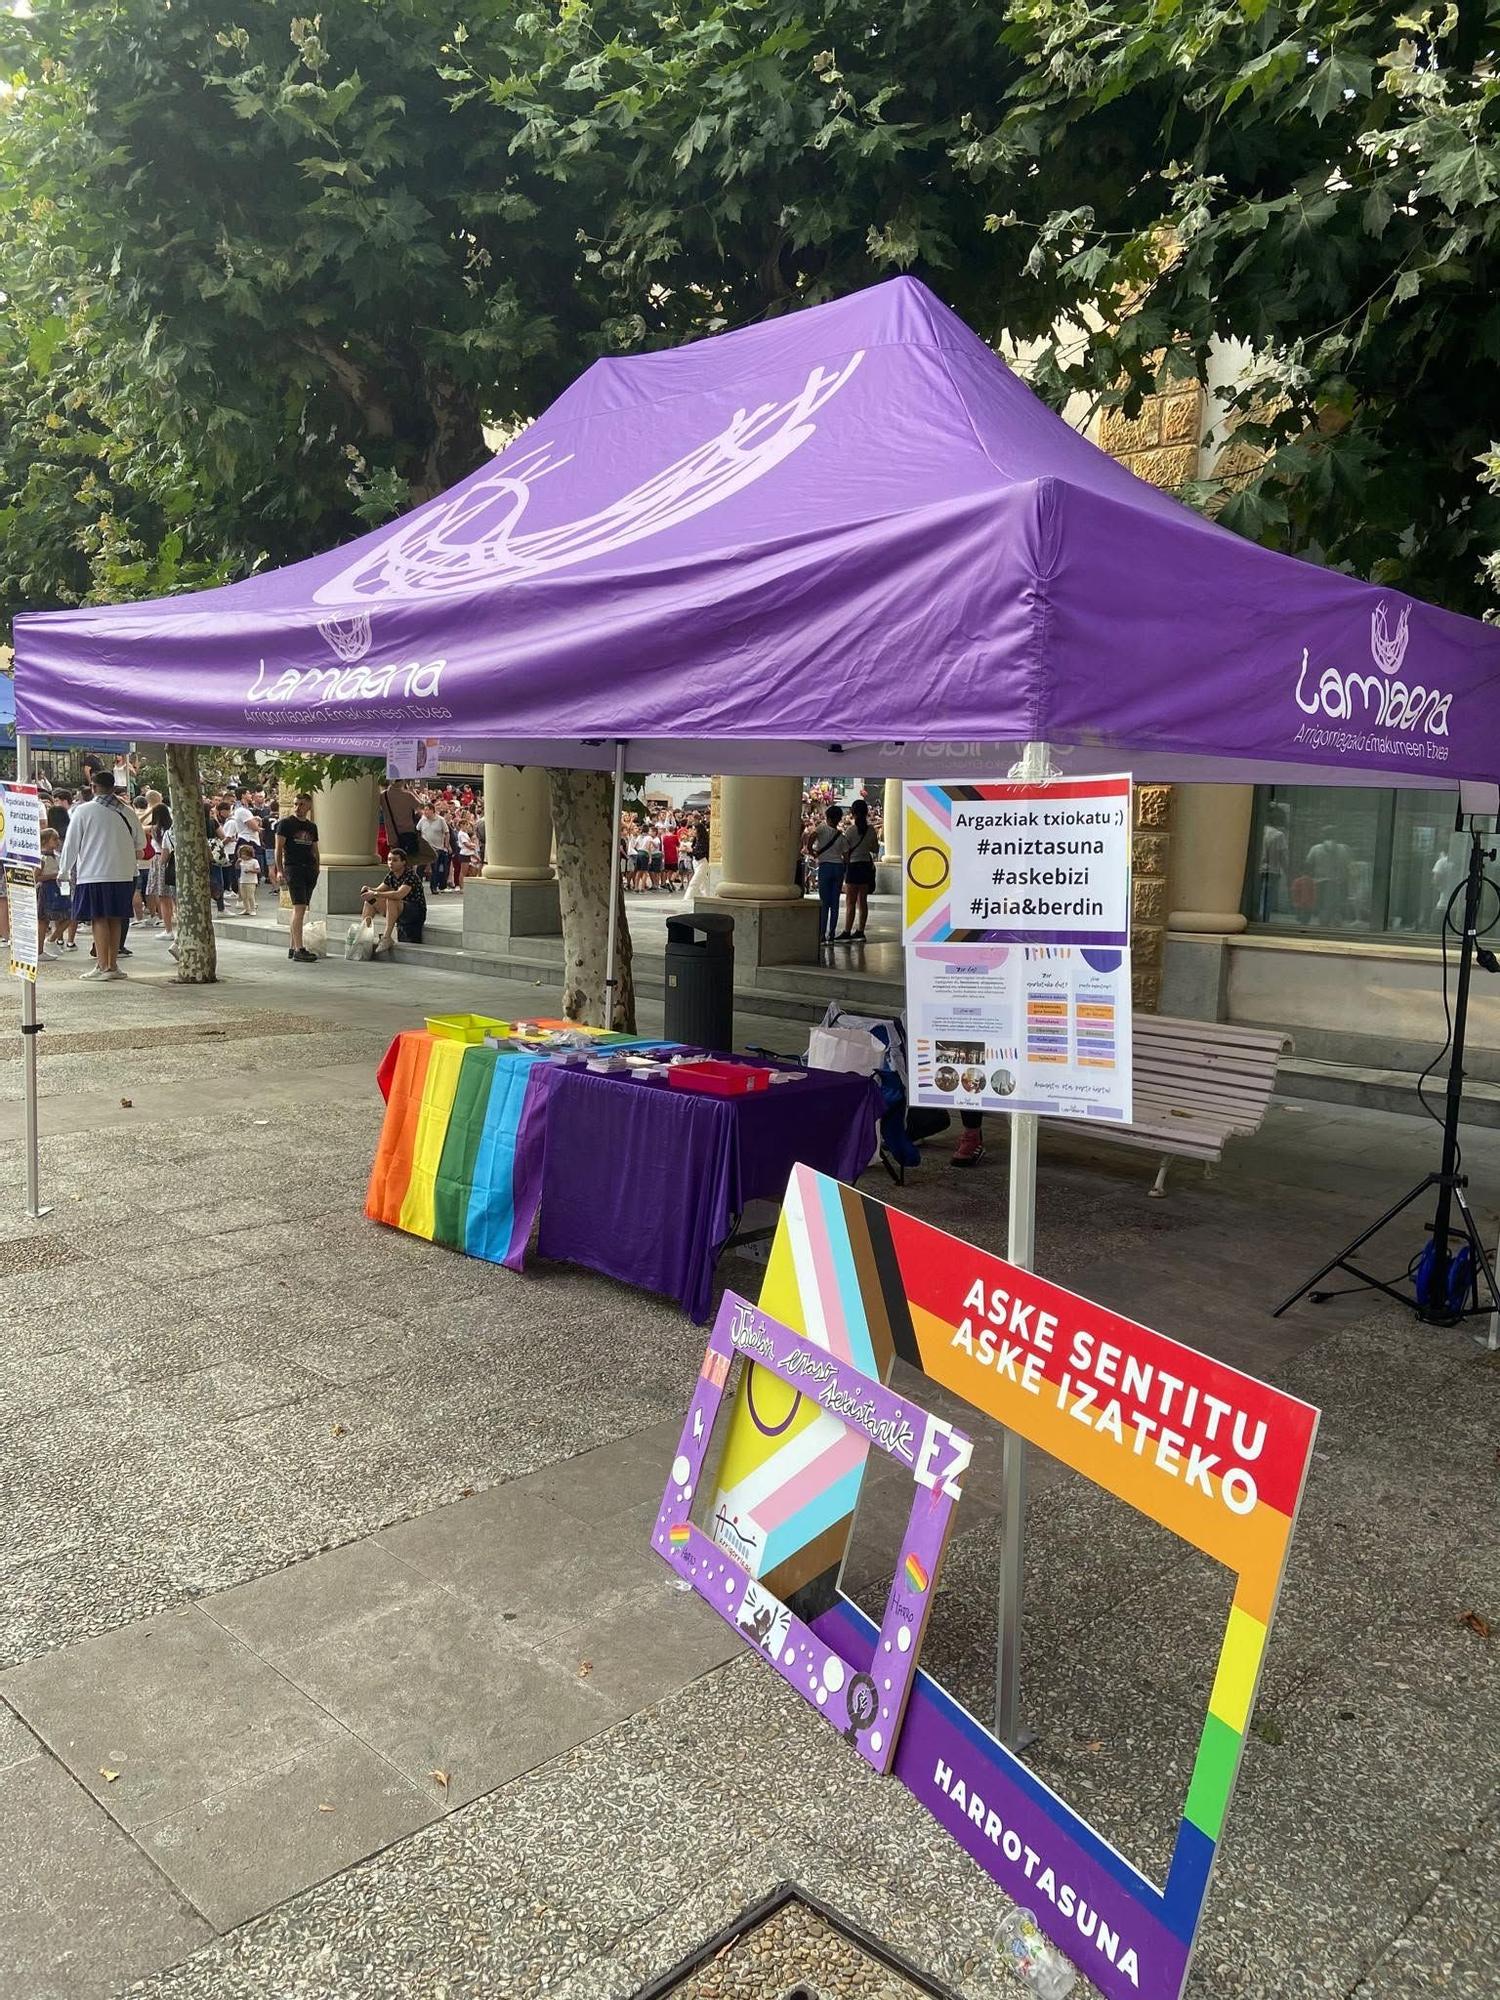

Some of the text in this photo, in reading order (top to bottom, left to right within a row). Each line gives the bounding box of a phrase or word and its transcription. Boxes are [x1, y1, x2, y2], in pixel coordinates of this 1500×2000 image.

[247, 658, 447, 702] Lamiaena
[1295, 647, 1454, 736] Lamiaena
[243, 704, 452, 725] Arrigorriagako Emakumeen Etxea
[1294, 723, 1449, 761] Arrigorriagako Emakumeen Etxea
[955, 812, 1039, 831] Argazkiak
[1044, 810, 1111, 826] txiokatu
[976, 838, 1104, 855] #aniztasuna
[991, 867, 1089, 885] #askebizi
[970, 897, 1103, 919] #jaia&berdin
[962, 1278, 1268, 1461] ASKE SENTITU
[950, 1318, 1258, 1516] ASKE IZATEKO
[913, 1412, 975, 1502] EZ
[933, 1758, 1139, 1989] HARROTASUNA
